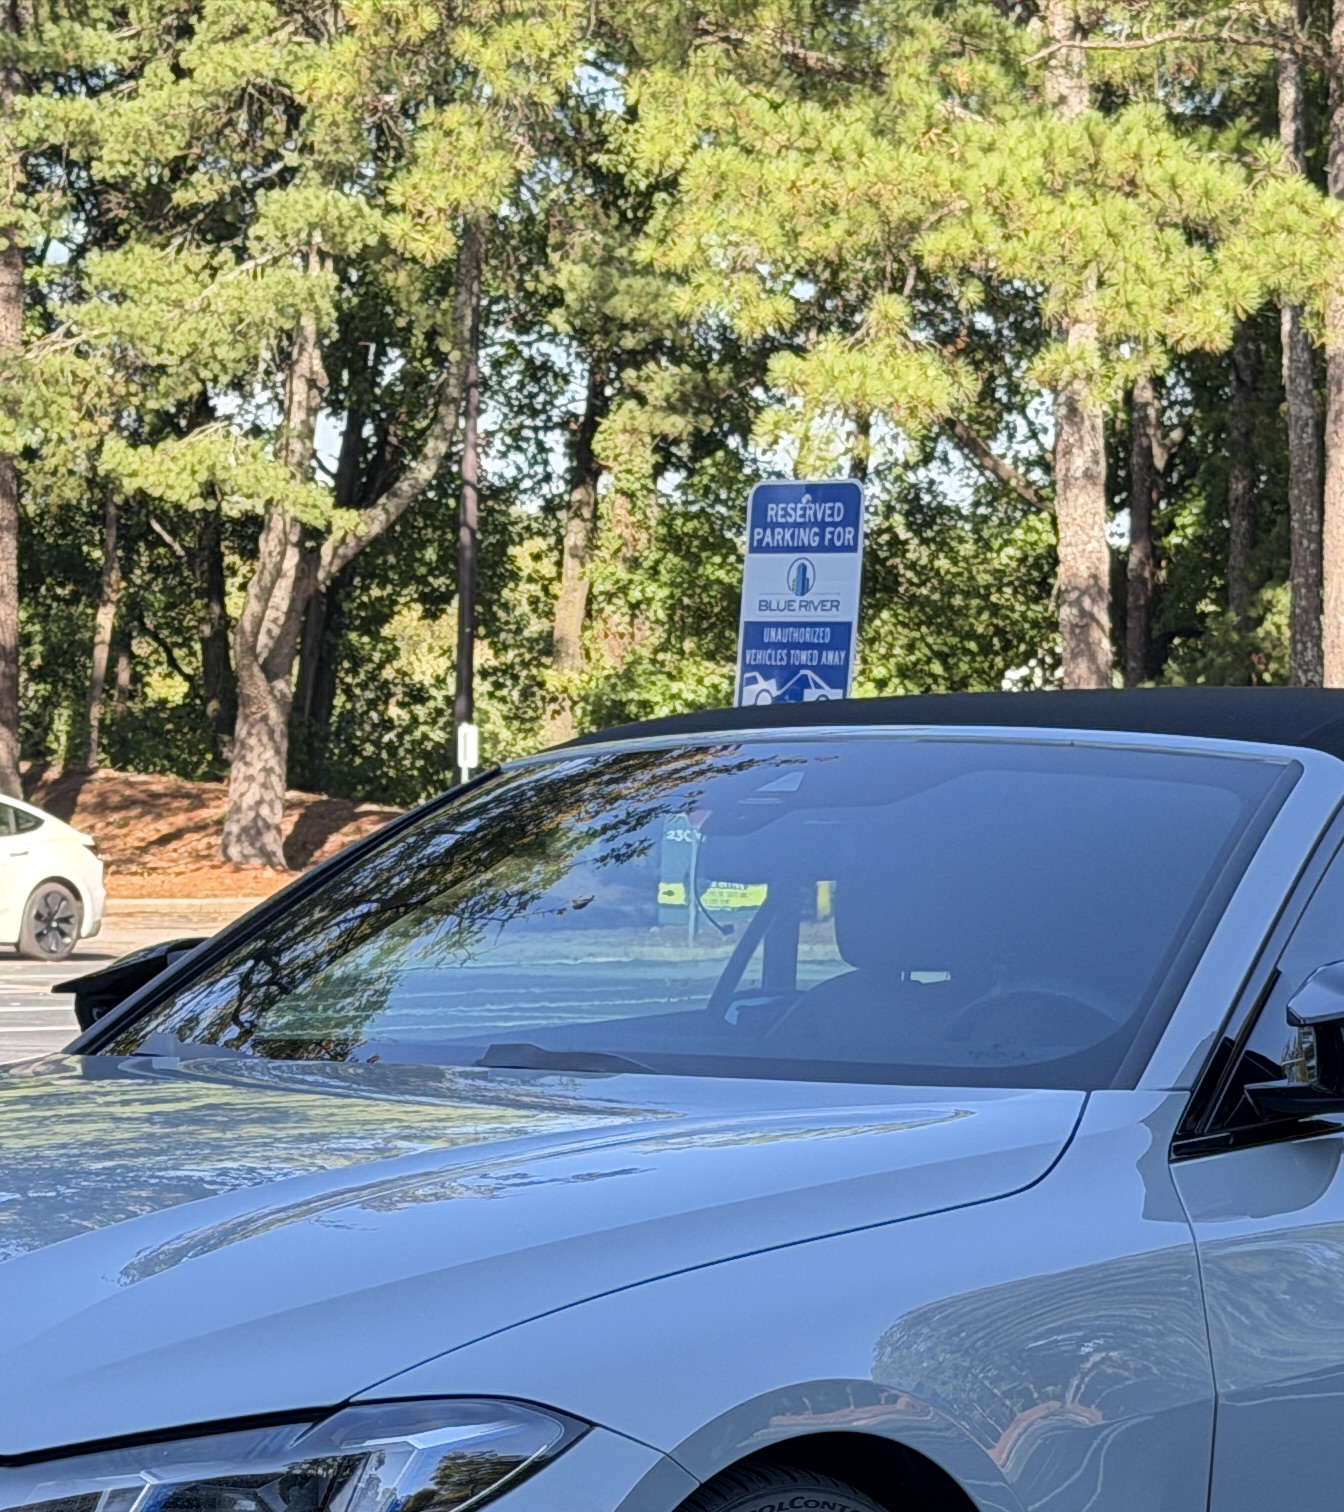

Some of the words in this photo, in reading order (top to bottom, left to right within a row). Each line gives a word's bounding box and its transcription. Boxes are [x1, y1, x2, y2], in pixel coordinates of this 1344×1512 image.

[767, 502, 844, 522] RESERVED
[753, 527, 820, 547] PARKING
[825, 527, 855, 546] FOR
[758, 599, 796, 612] BLUE
[798, 599, 840, 612] RIVER
[763, 627, 831, 643] UNAUTHORIZED
[745, 649, 787, 665] VEHICLES
[790, 649, 818, 665] TOWED
[820, 649, 846, 665] AWAY
